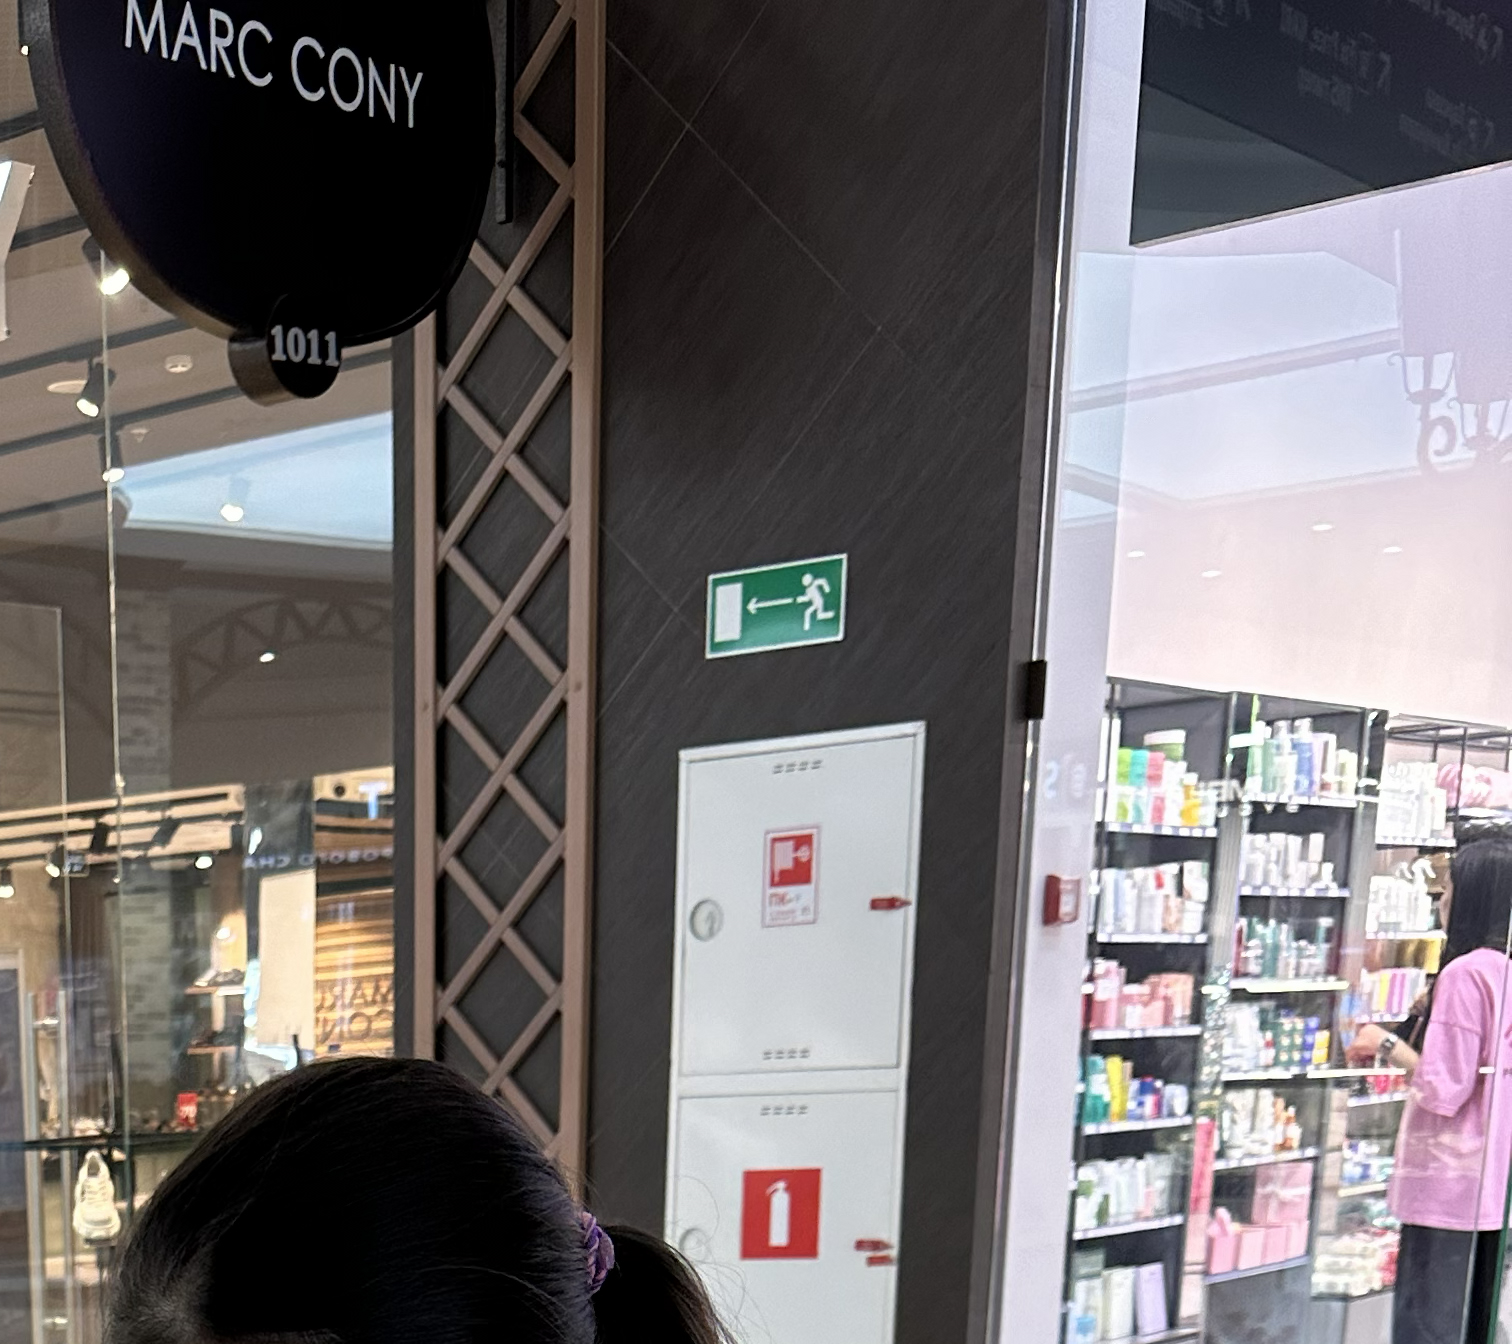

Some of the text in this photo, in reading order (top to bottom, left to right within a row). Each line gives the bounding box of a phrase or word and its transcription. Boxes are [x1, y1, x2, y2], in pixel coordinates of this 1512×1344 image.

[124, 0, 424, 128] MARC CONY
[270, 325, 339, 368] 1011
